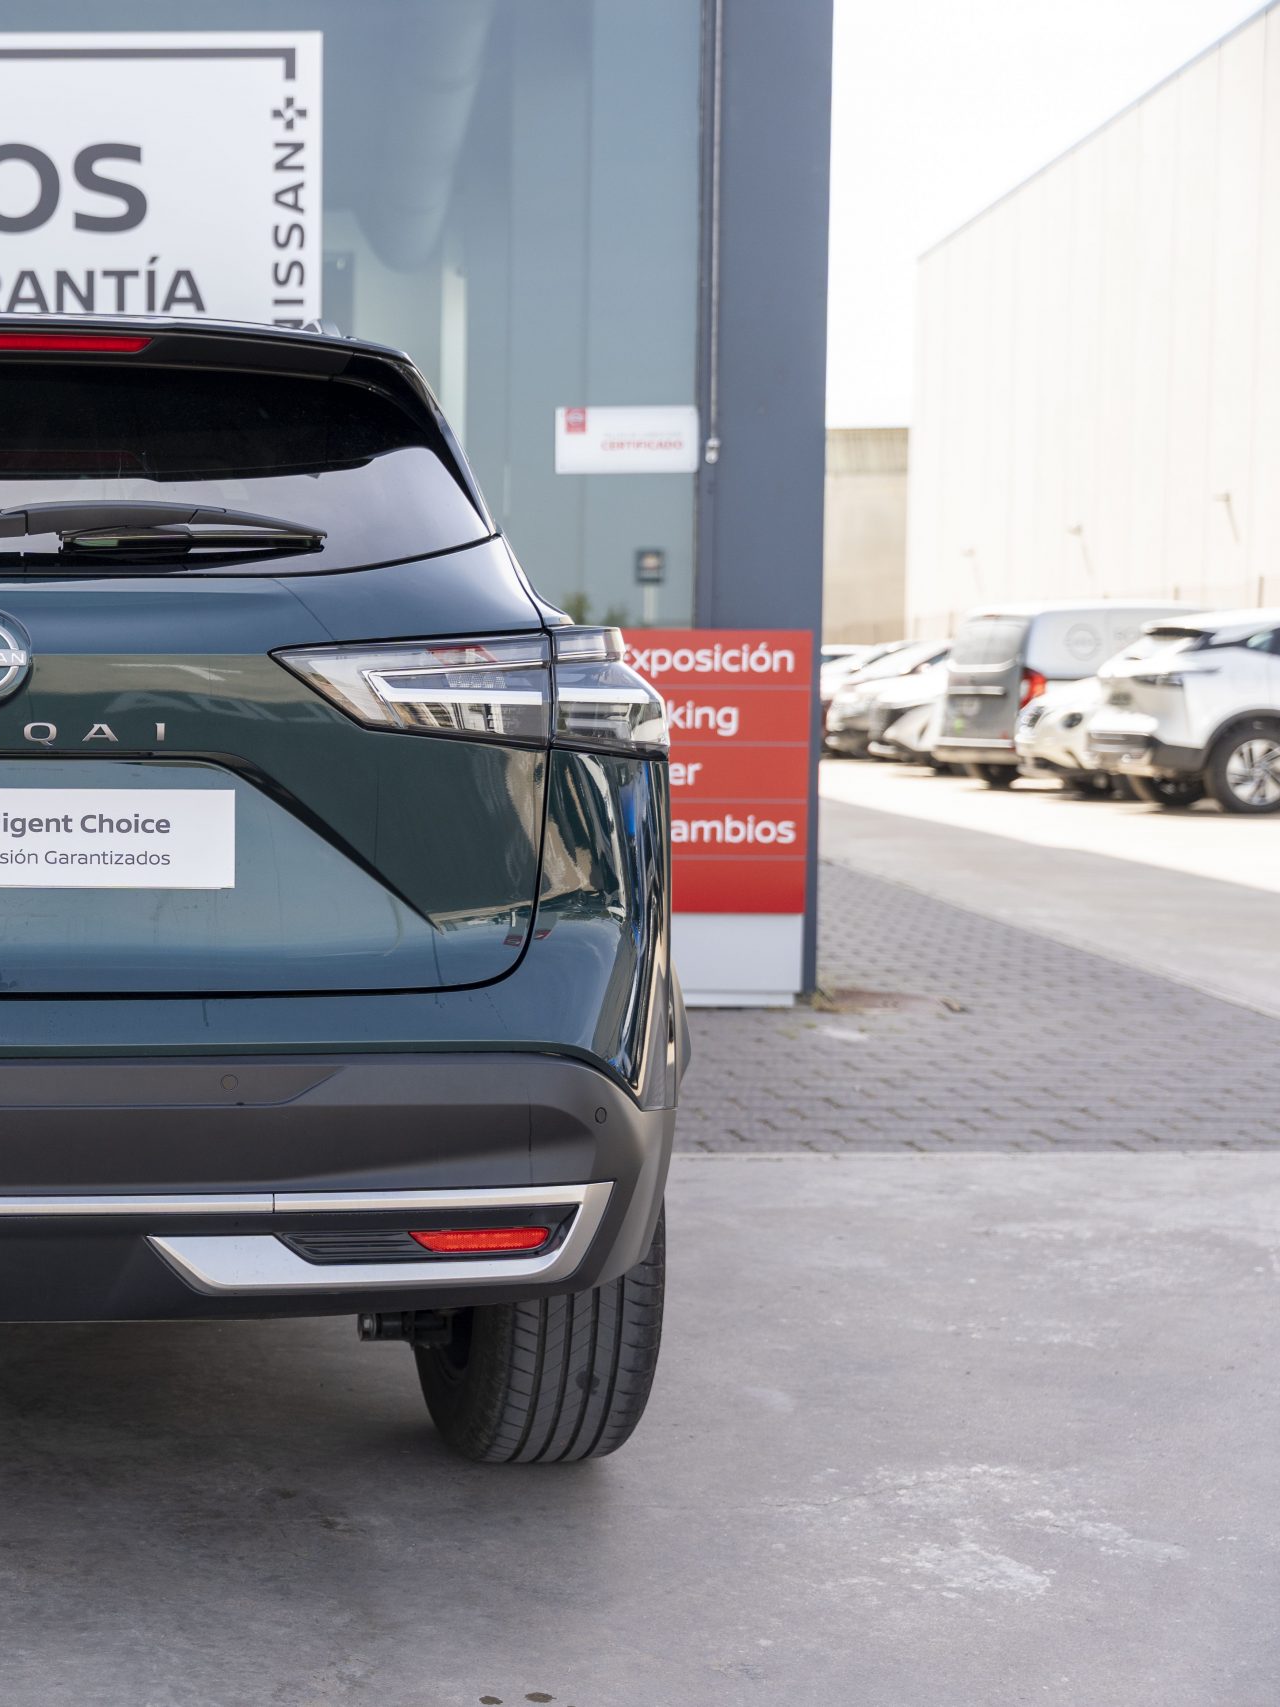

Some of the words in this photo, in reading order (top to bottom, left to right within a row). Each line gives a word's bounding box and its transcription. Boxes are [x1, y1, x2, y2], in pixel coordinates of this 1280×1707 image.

[80, 813, 171, 834] Choice
[669, 814, 797, 844] ambios
[44, 850, 171, 866] Garantizados
